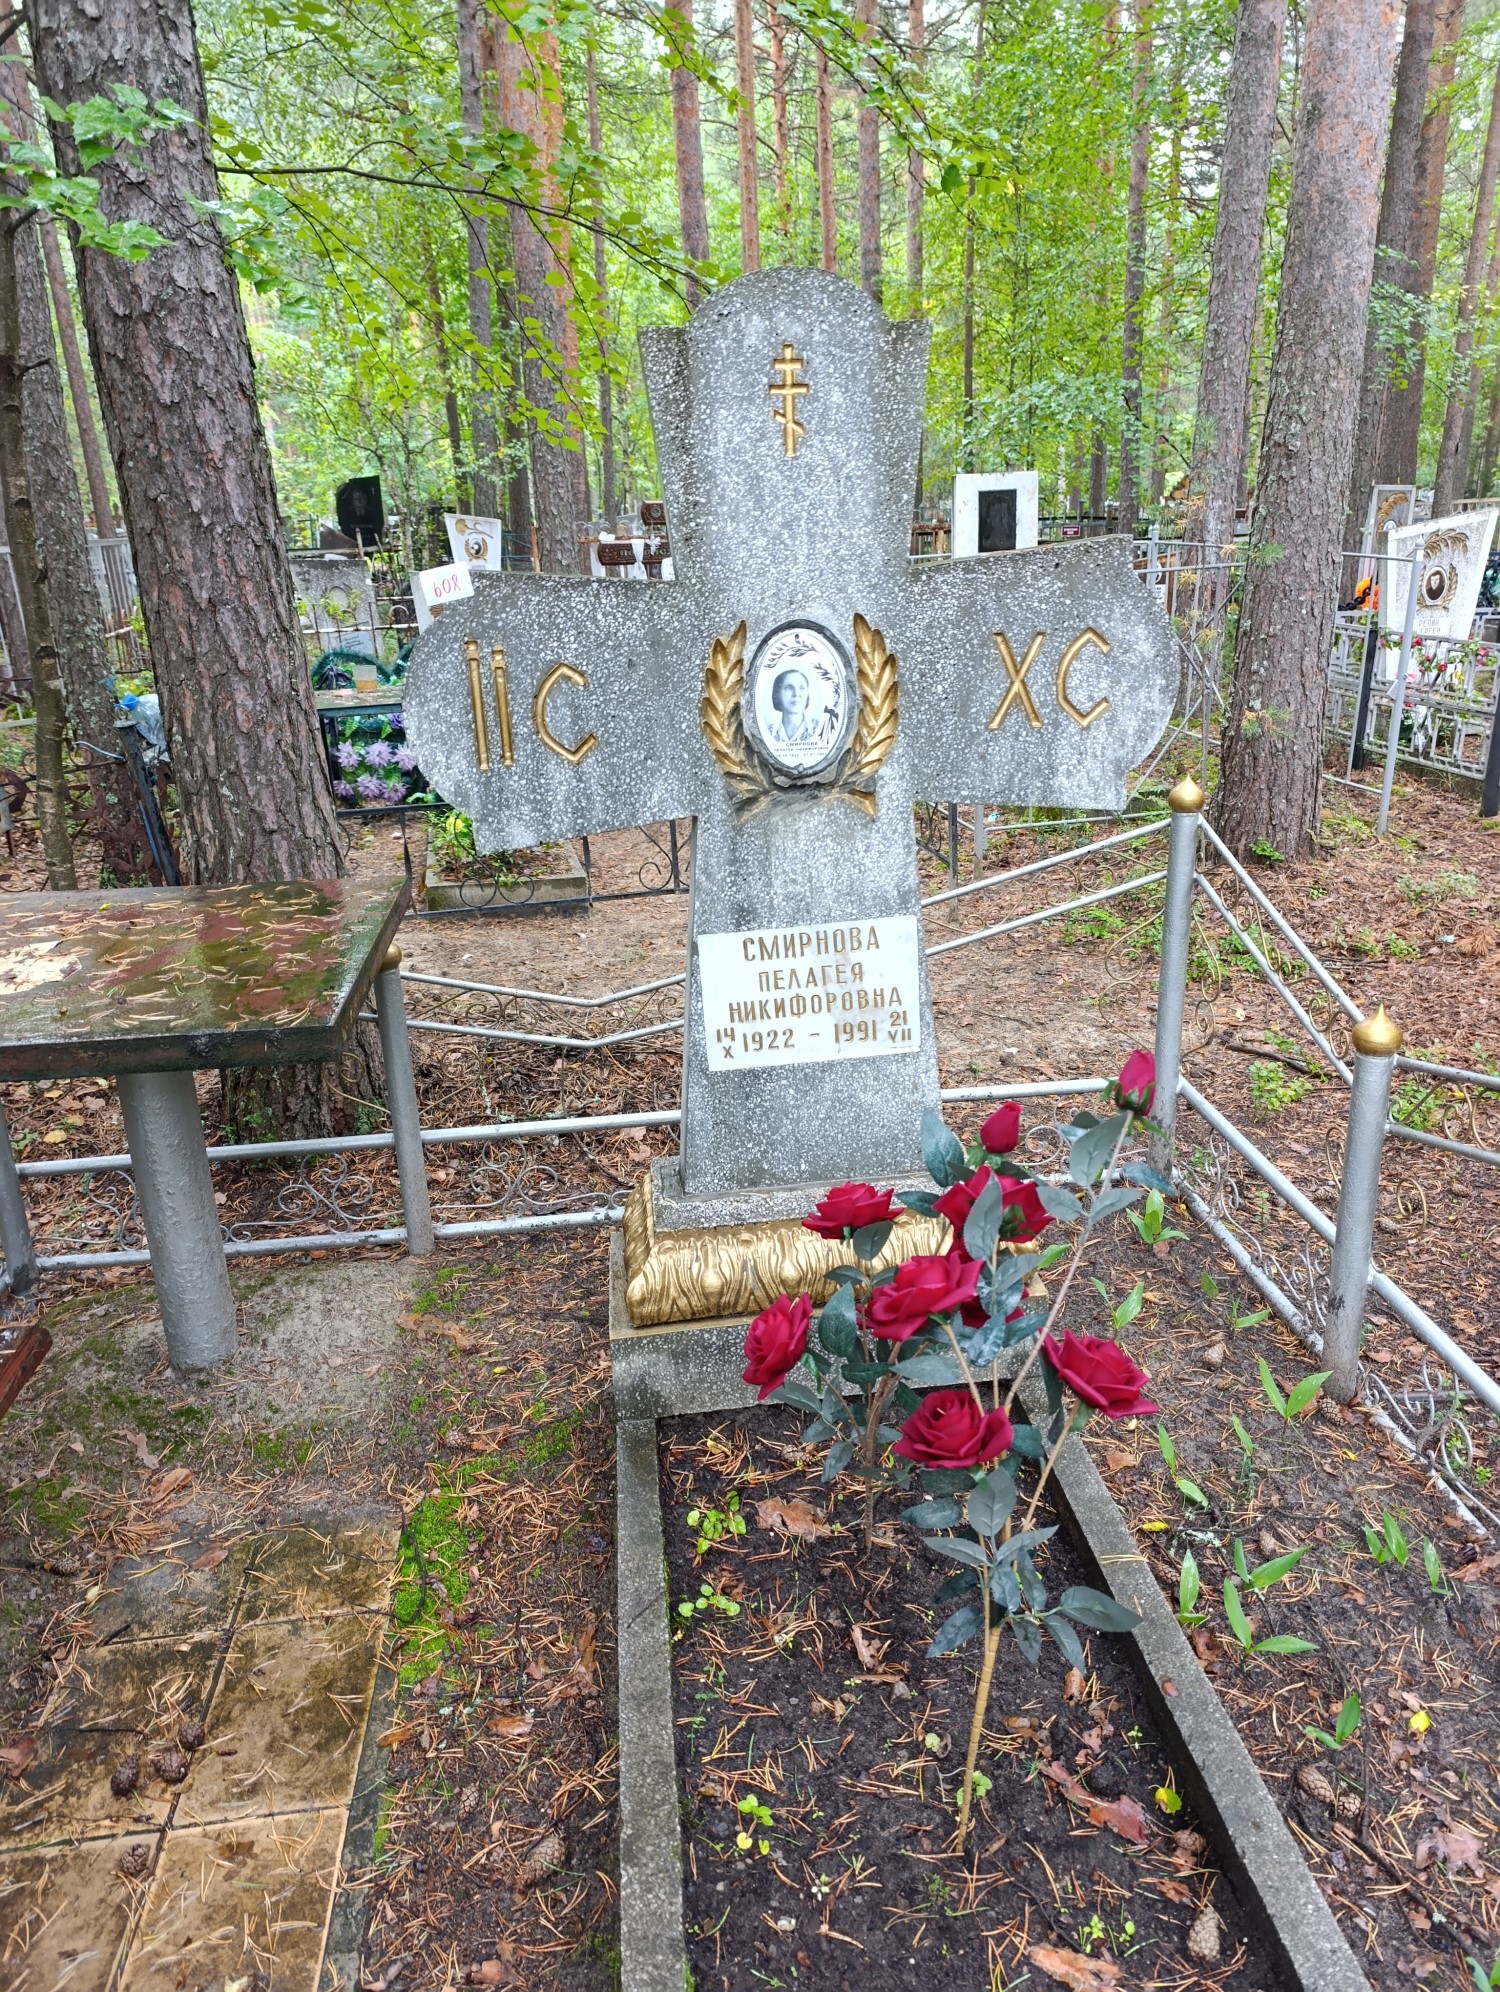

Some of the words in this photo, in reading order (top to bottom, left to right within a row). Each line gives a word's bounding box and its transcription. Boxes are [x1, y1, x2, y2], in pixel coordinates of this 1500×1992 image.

[433, 574, 462, 599] 608
[742, 925, 880, 962] СМИРНОВА
[758, 962, 864, 992] ПЕЛАГЕЯ
[728, 986, 902, 1023] НИКИФОРОВНА
[889, 1010, 908, 1028] 21
[716, 1027, 736, 1044] 14
[742, 1028, 795, 1052] 1922
[834, 1019, 877, 1044] 1991
